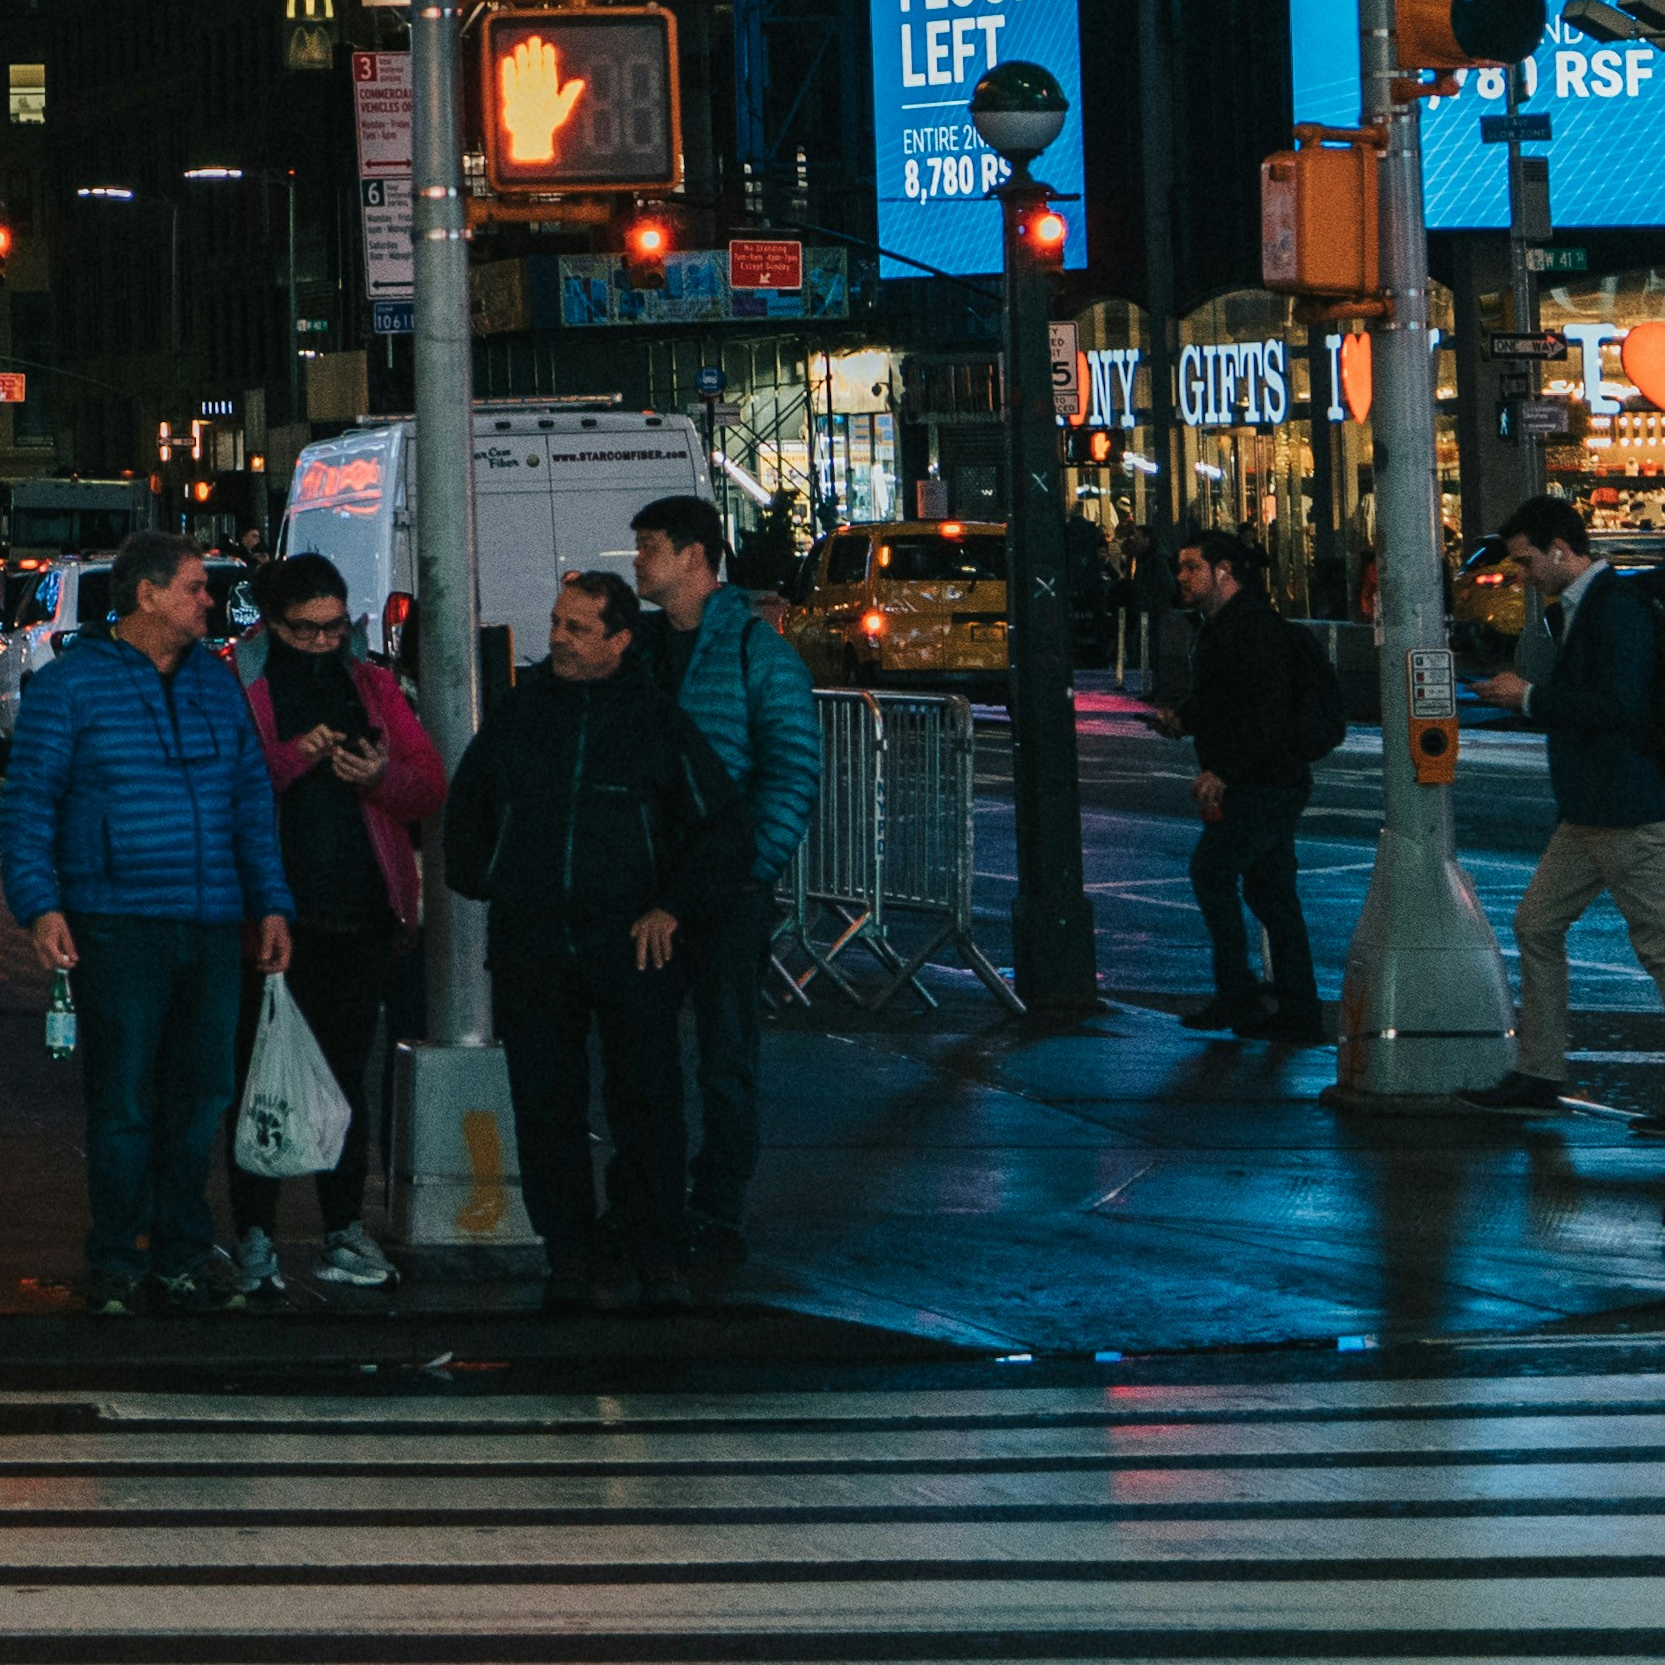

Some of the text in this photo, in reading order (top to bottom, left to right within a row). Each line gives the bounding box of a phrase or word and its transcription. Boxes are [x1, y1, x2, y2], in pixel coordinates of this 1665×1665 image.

[901, 14, 1005, 87] LEFT
[360, 57, 372, 80] 3
[1555, 49, 1654, 98] RSF
[361, 102, 400, 113] VEHICLES
[903, 124, 990, 154] ENTIRE 2N
[904, 155, 974, 205] 8,780
[368, 182, 380, 205] 6
[1545, 252, 1556, 266] W
[1560, 250, 1573, 267] 41
[377, 314, 414, 329] 10611
[1532, 340, 1557, 352] WAY
[1052, 361, 1072, 386] 5
[1087, 349, 1139, 427] NY
[1179, 338, 1287, 426] GIFTS
[552, 450, 688, 462] www.STARCOMFIBER.com
